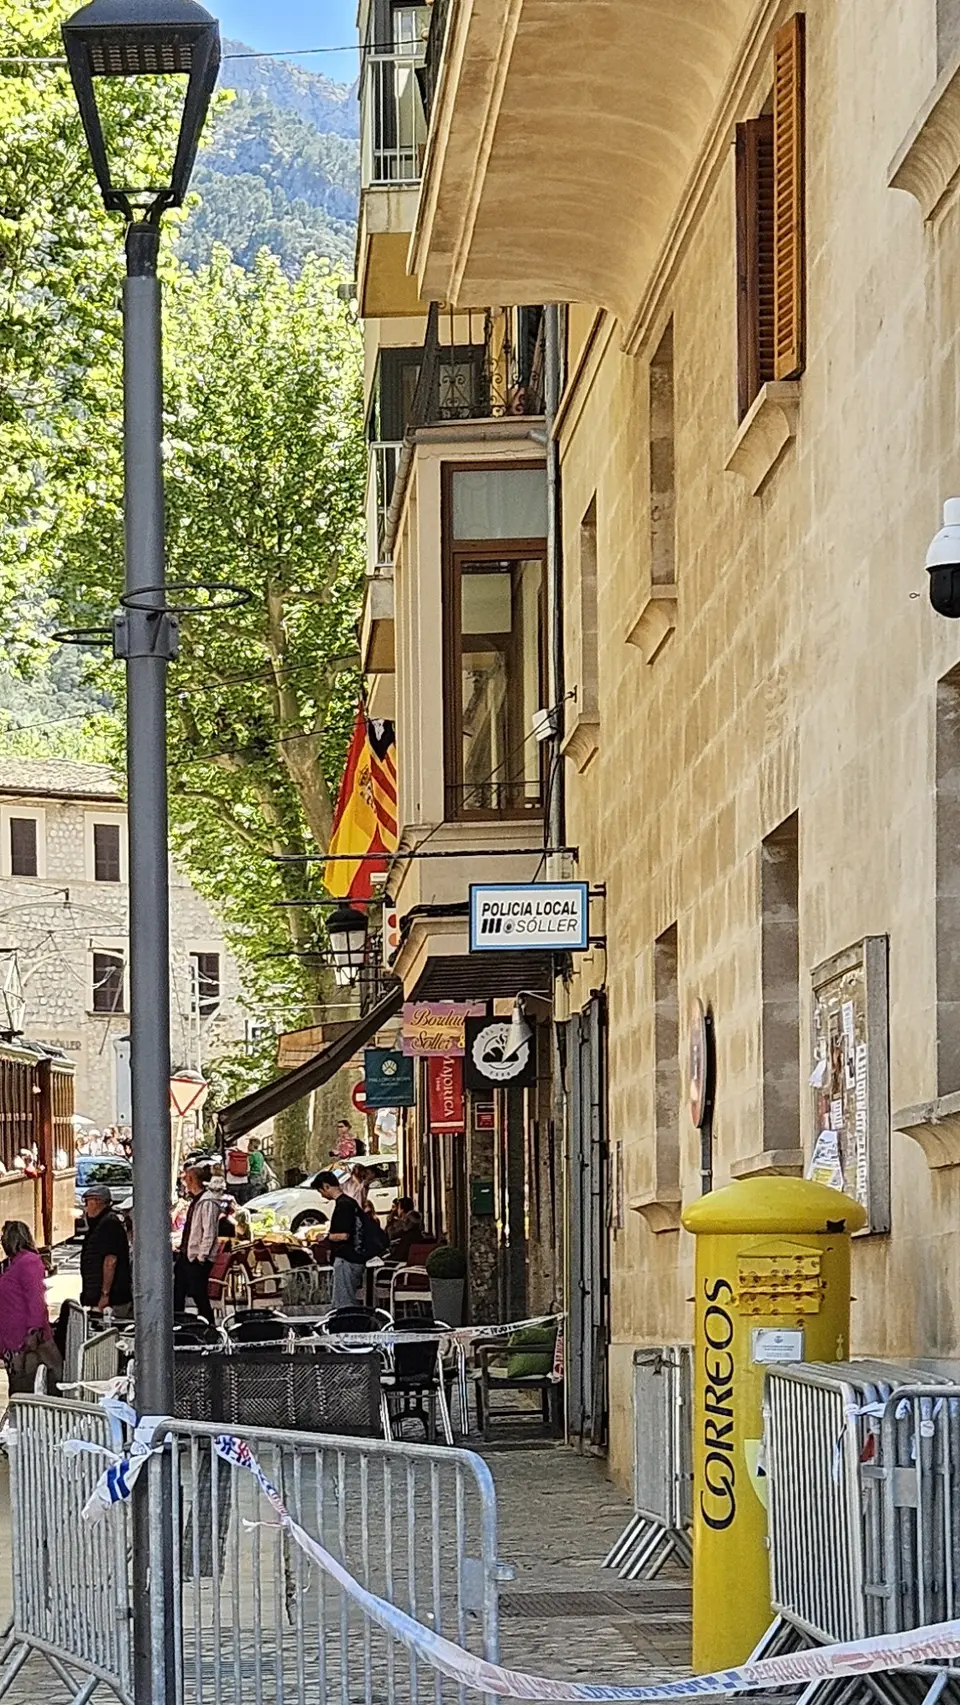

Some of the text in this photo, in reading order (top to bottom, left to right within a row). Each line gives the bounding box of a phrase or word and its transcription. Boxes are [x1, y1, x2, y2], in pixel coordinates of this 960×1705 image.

[481, 900, 578, 917] POLICIA LOCAL
[515, 916, 578, 933] SÓLLER
[700, 1277, 737, 1531] CORREOS
